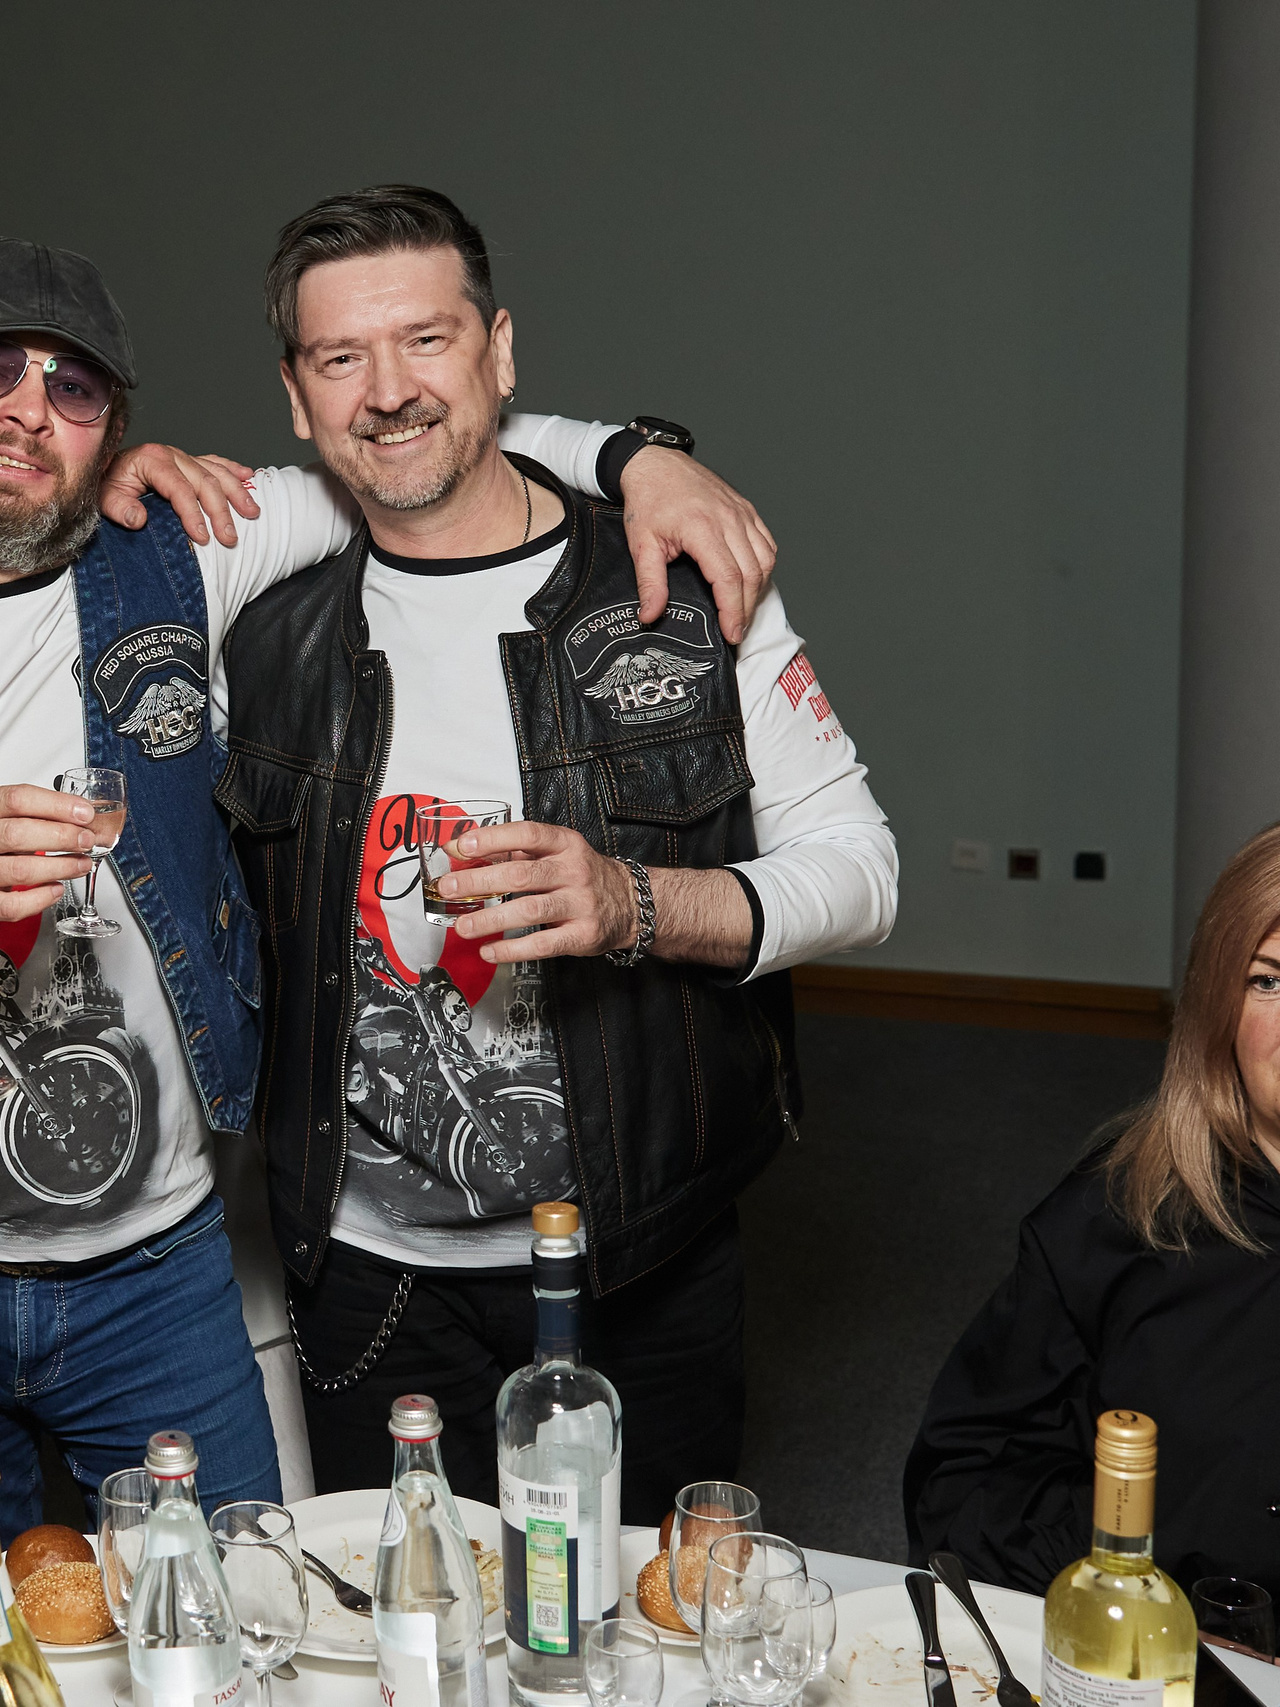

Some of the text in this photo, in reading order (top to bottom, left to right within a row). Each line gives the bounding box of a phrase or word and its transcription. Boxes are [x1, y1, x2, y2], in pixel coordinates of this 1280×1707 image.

[571, 607, 695, 648] RED SQUARE PTER
[100, 631, 202, 681] RED SQUARE CHAPTER
[135, 645, 175, 665] RUSSIA
[614, 674, 687, 712] HOG
[146, 705, 198, 745] HOG
[622, 710, 645, 722] HARLEY
[212, 1677, 242, 1705] TASSA
